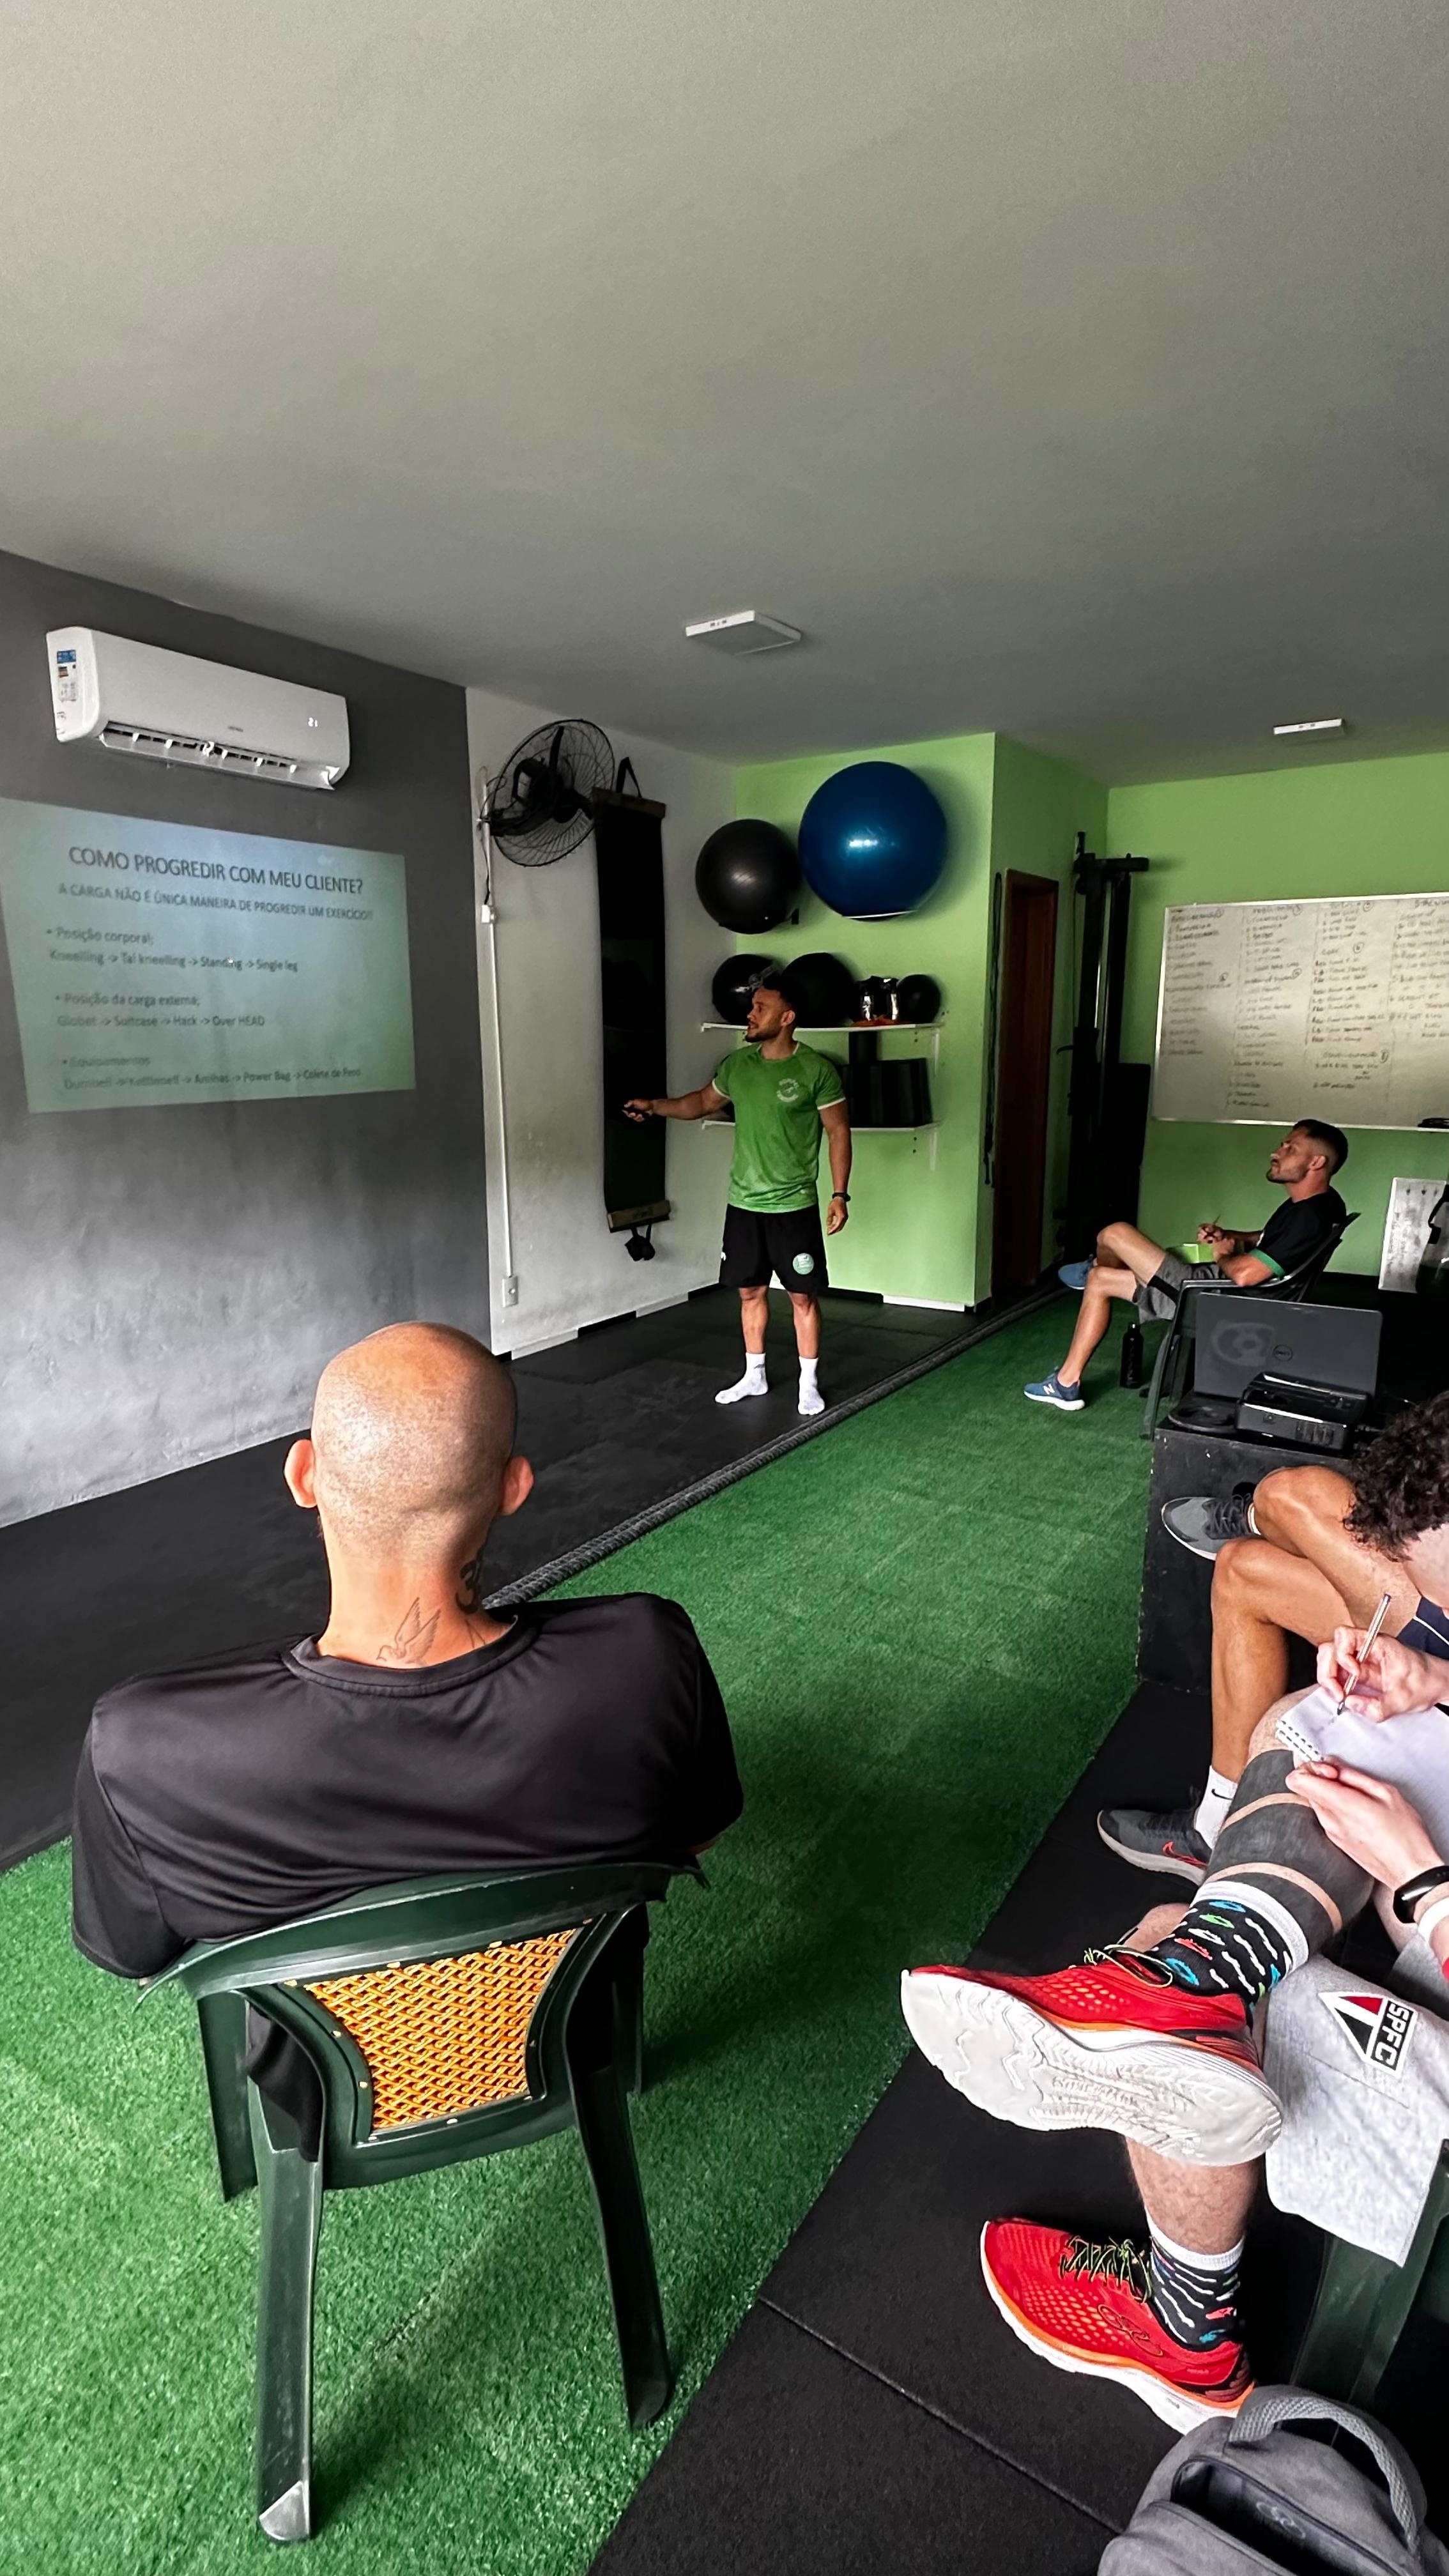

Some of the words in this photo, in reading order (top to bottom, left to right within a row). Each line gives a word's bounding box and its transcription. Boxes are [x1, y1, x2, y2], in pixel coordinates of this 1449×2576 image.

[69, 847, 128, 870] COMO
[135, 854, 226, 880] PROGREDIR
[229, 866, 266, 884] COM
[270, 870, 302, 888] MEU
[305, 875, 363, 894] CLIENTE?
[70, 884, 112, 899] CARGA
[115, 887, 141, 902] NÃO
[190, 895, 236, 909] MANEIRA
[240, 900, 252, 912] DE
[254, 902, 306, 916] PROGREDIR
[309, 907, 323, 917] UM
[112, 994, 125, 1005] da
[128, 996, 156, 1008] carga
[1374, 2002, 1407, 2067] SPFC
